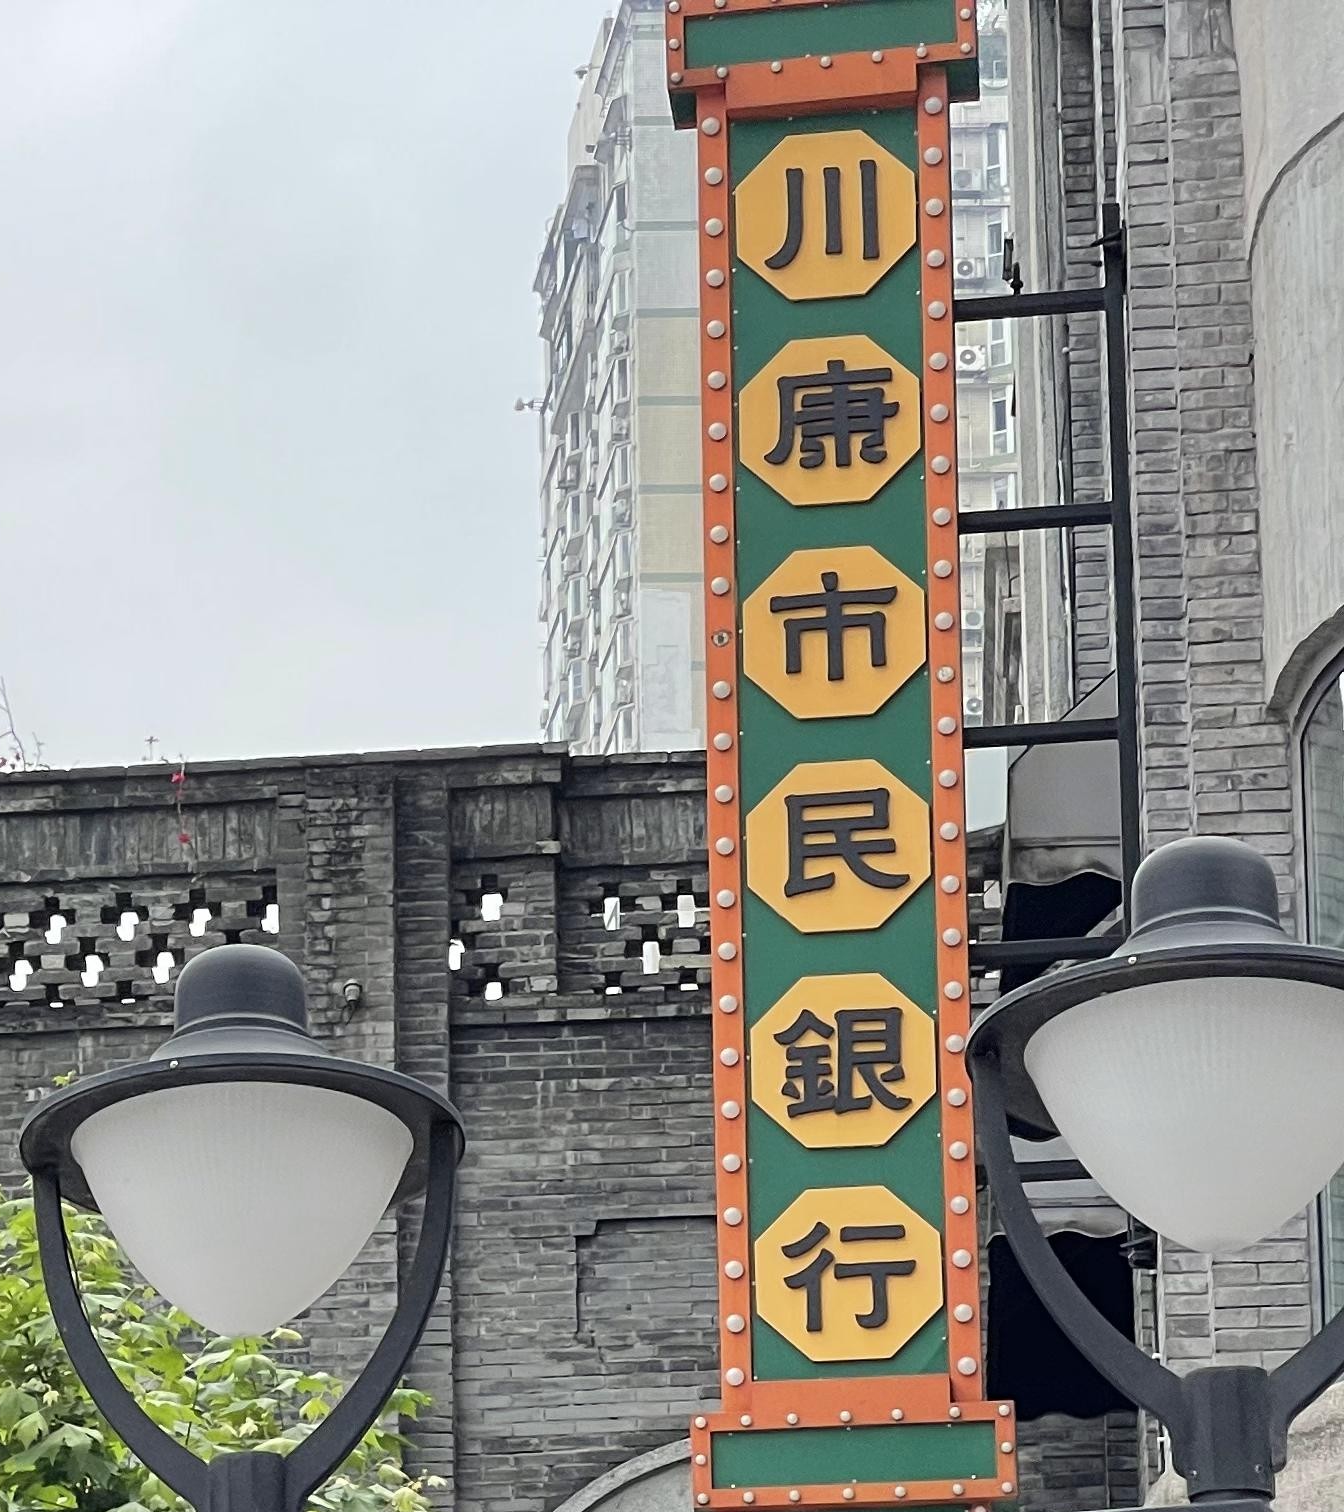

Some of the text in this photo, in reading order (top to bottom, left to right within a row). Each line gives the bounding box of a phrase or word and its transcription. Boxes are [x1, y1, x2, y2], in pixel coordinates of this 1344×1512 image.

[764, 159, 917, 1333] 川康市民銀行
